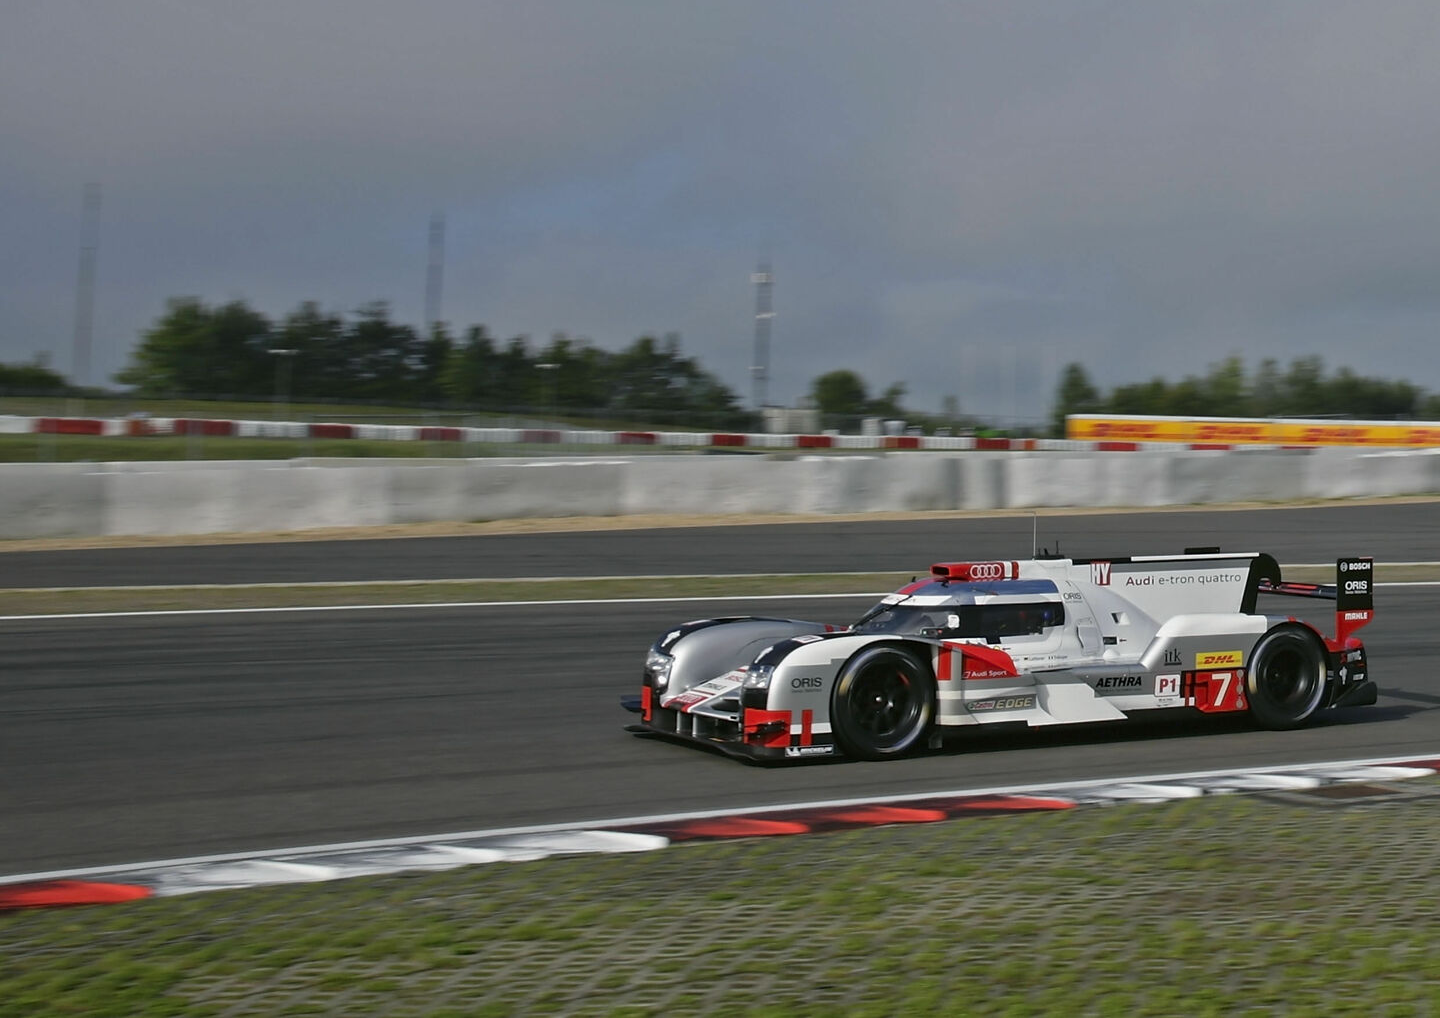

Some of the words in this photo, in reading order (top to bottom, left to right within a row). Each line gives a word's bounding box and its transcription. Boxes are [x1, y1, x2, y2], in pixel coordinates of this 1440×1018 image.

[1349, 562, 1371, 570] BOSCH
[1090, 562, 1111, 585] HY
[1126, 576, 1155, 586] Audi
[1158, 575, 1195, 585] e-tron
[1197, 573, 1242, 584] quattro
[1345, 581, 1368, 590] ORIS
[1345, 612, 1368, 620] MAHLE
[1204, 655, 1236, 664] DHL
[988, 670, 1007, 678] Sport
[791, 677, 823, 688] ORIS
[1096, 676, 1142, 688] AETHRA
[1159, 678, 1177, 693] P1
[1211, 672, 1232, 707] 7
[995, 697, 1033, 709] EDGE
